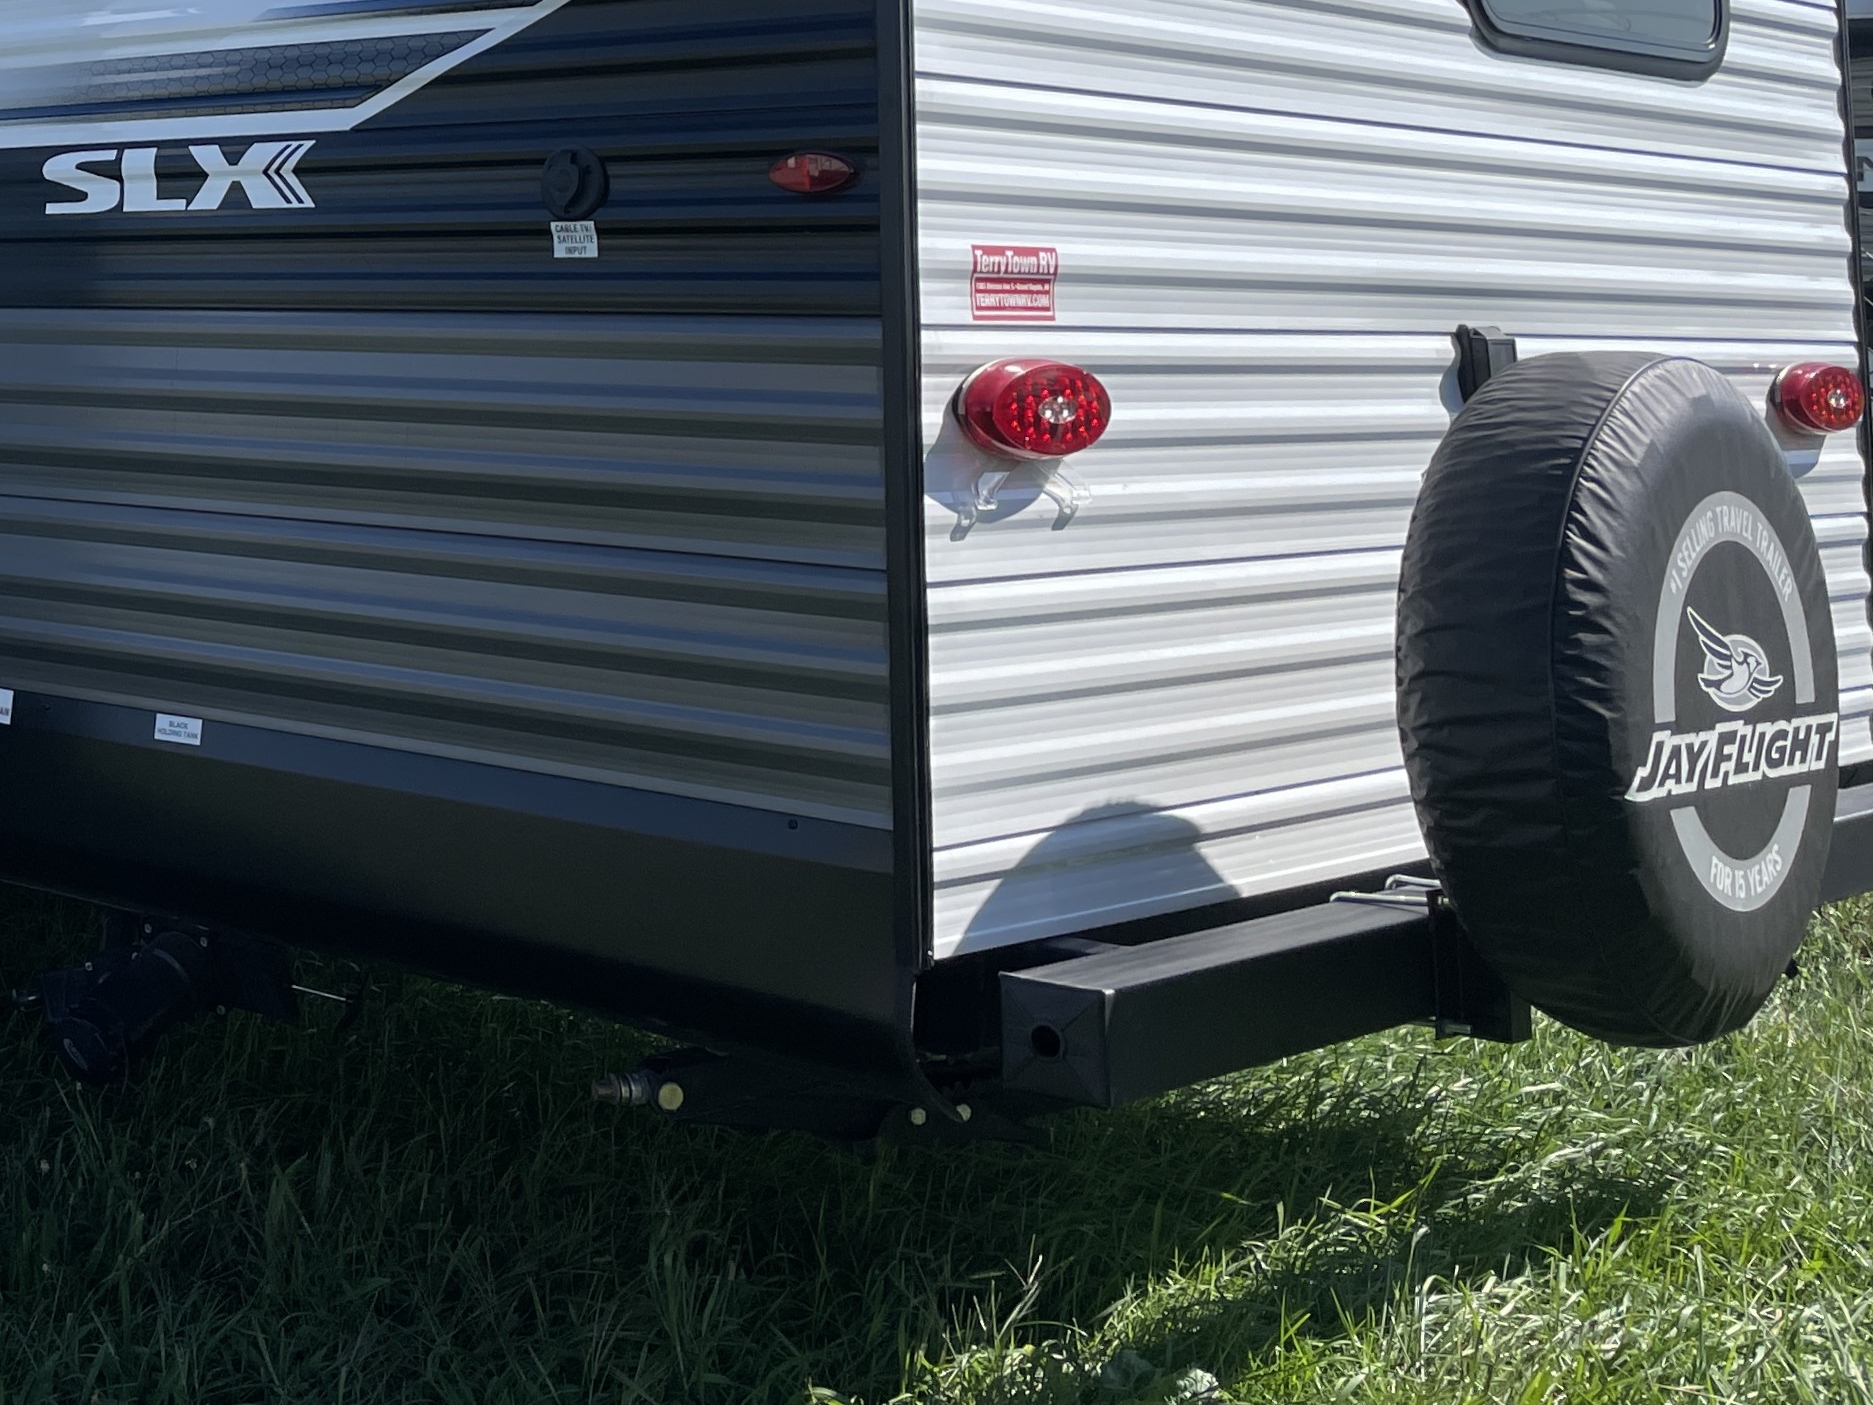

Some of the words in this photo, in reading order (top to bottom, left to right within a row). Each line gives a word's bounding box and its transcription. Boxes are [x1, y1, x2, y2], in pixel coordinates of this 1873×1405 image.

[42, 140, 316, 214] SLX
[555, 223, 578, 233] CABLE
[557, 235, 595, 244] SATELLITE
[565, 245, 587, 255] INPUT
[1038, 251, 1056, 274] RV
[1677, 510, 1715, 578] SELLING
[1716, 505, 1753, 542] TRAVEL
[1756, 522, 1793, 602] TRAILER
[169, 720, 189, 730] BLACK
[1710, 855, 1733, 896] FOR
[1734, 864, 1745, 898] 15
[1747, 843, 1783, 896] YEARS
